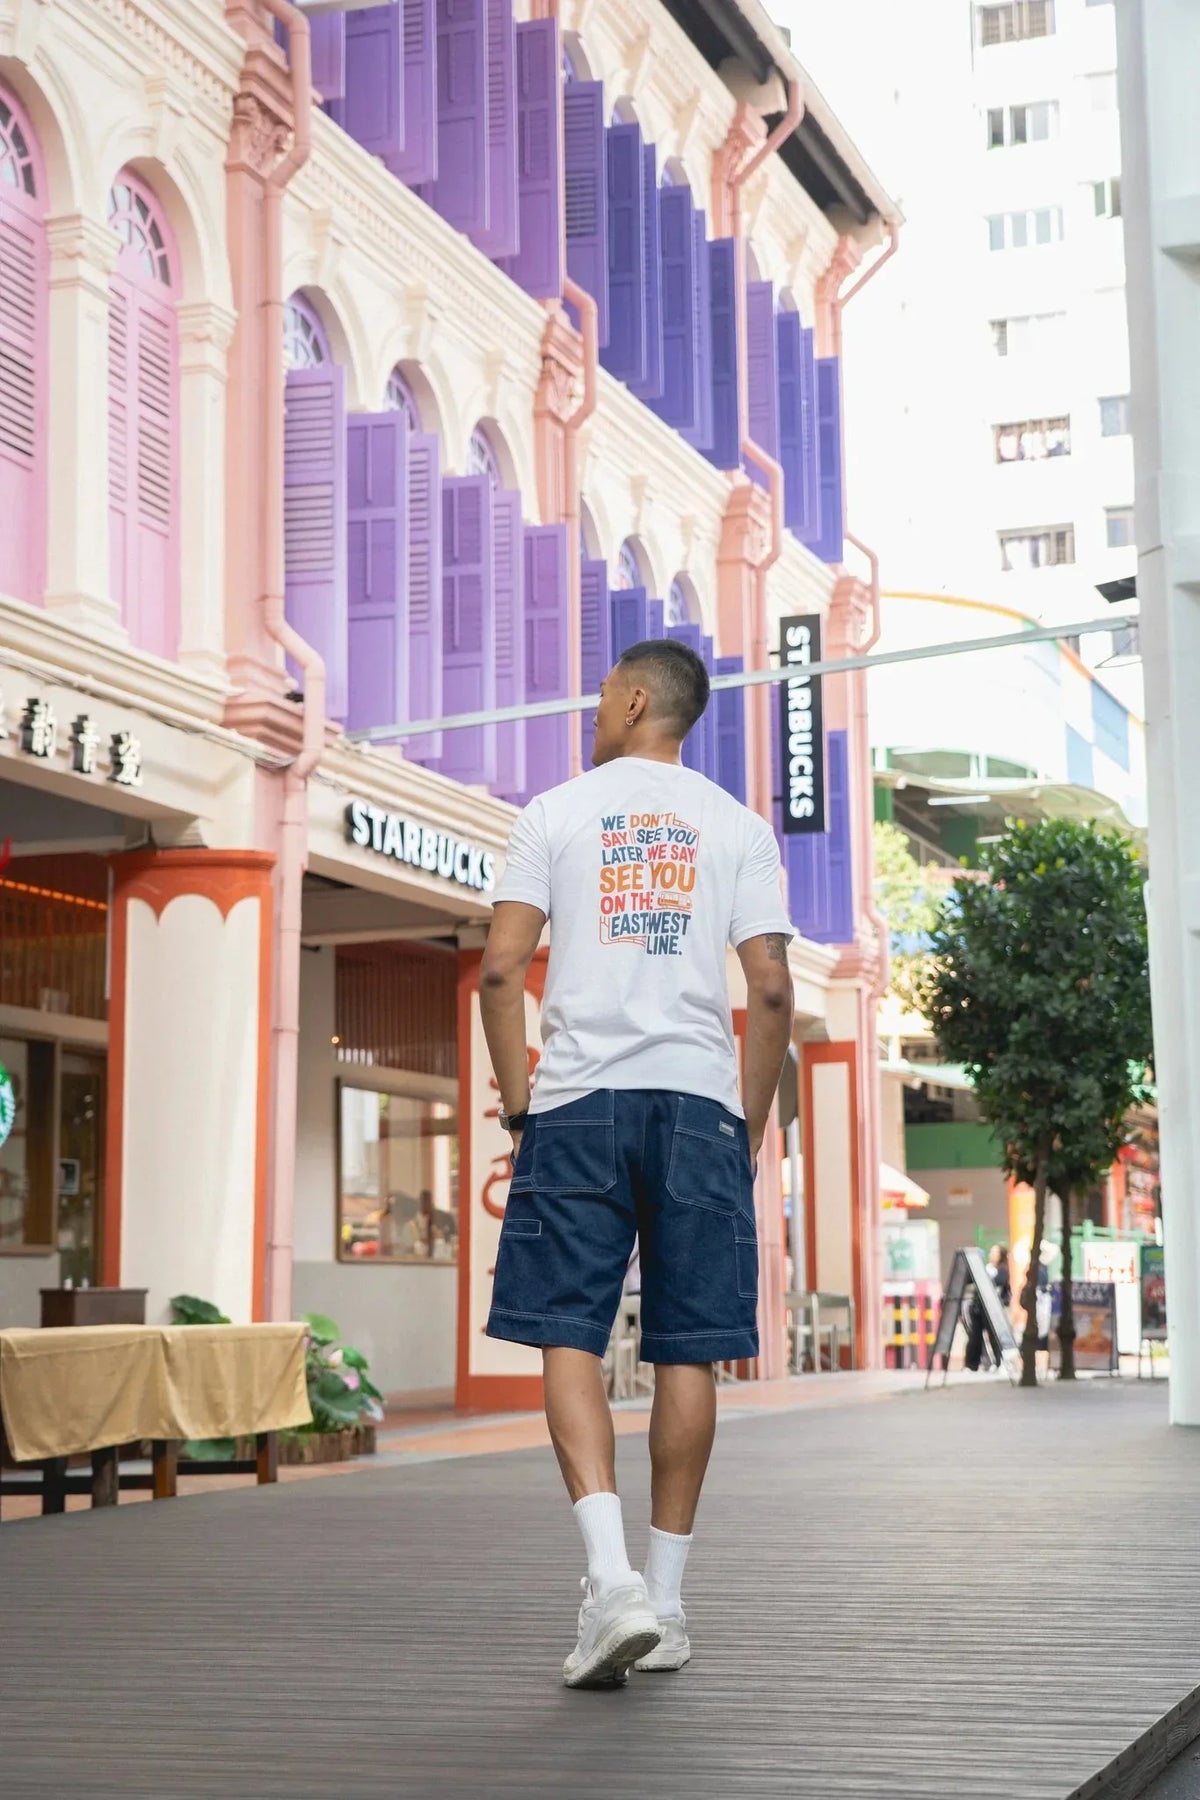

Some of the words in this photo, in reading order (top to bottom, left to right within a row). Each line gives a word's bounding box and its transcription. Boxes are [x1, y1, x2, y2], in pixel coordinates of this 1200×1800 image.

[601, 815, 625, 831] WE
[630, 812, 672, 828] DON'T
[350, 799, 496, 892] STARBUCKS
[601, 831, 628, 848] SAY
[636, 827, 663, 844] SEE
[667, 828, 697, 846] YOU
[602, 845, 648, 866] LATER,
[647, 844, 667, 861] WE
[671, 844, 695, 863] SAY
[600, 863, 644, 894] SEE
[649, 861, 695, 893] YOU
[600, 893, 626, 915] ON
[646, 935, 682, 955] LINE.
